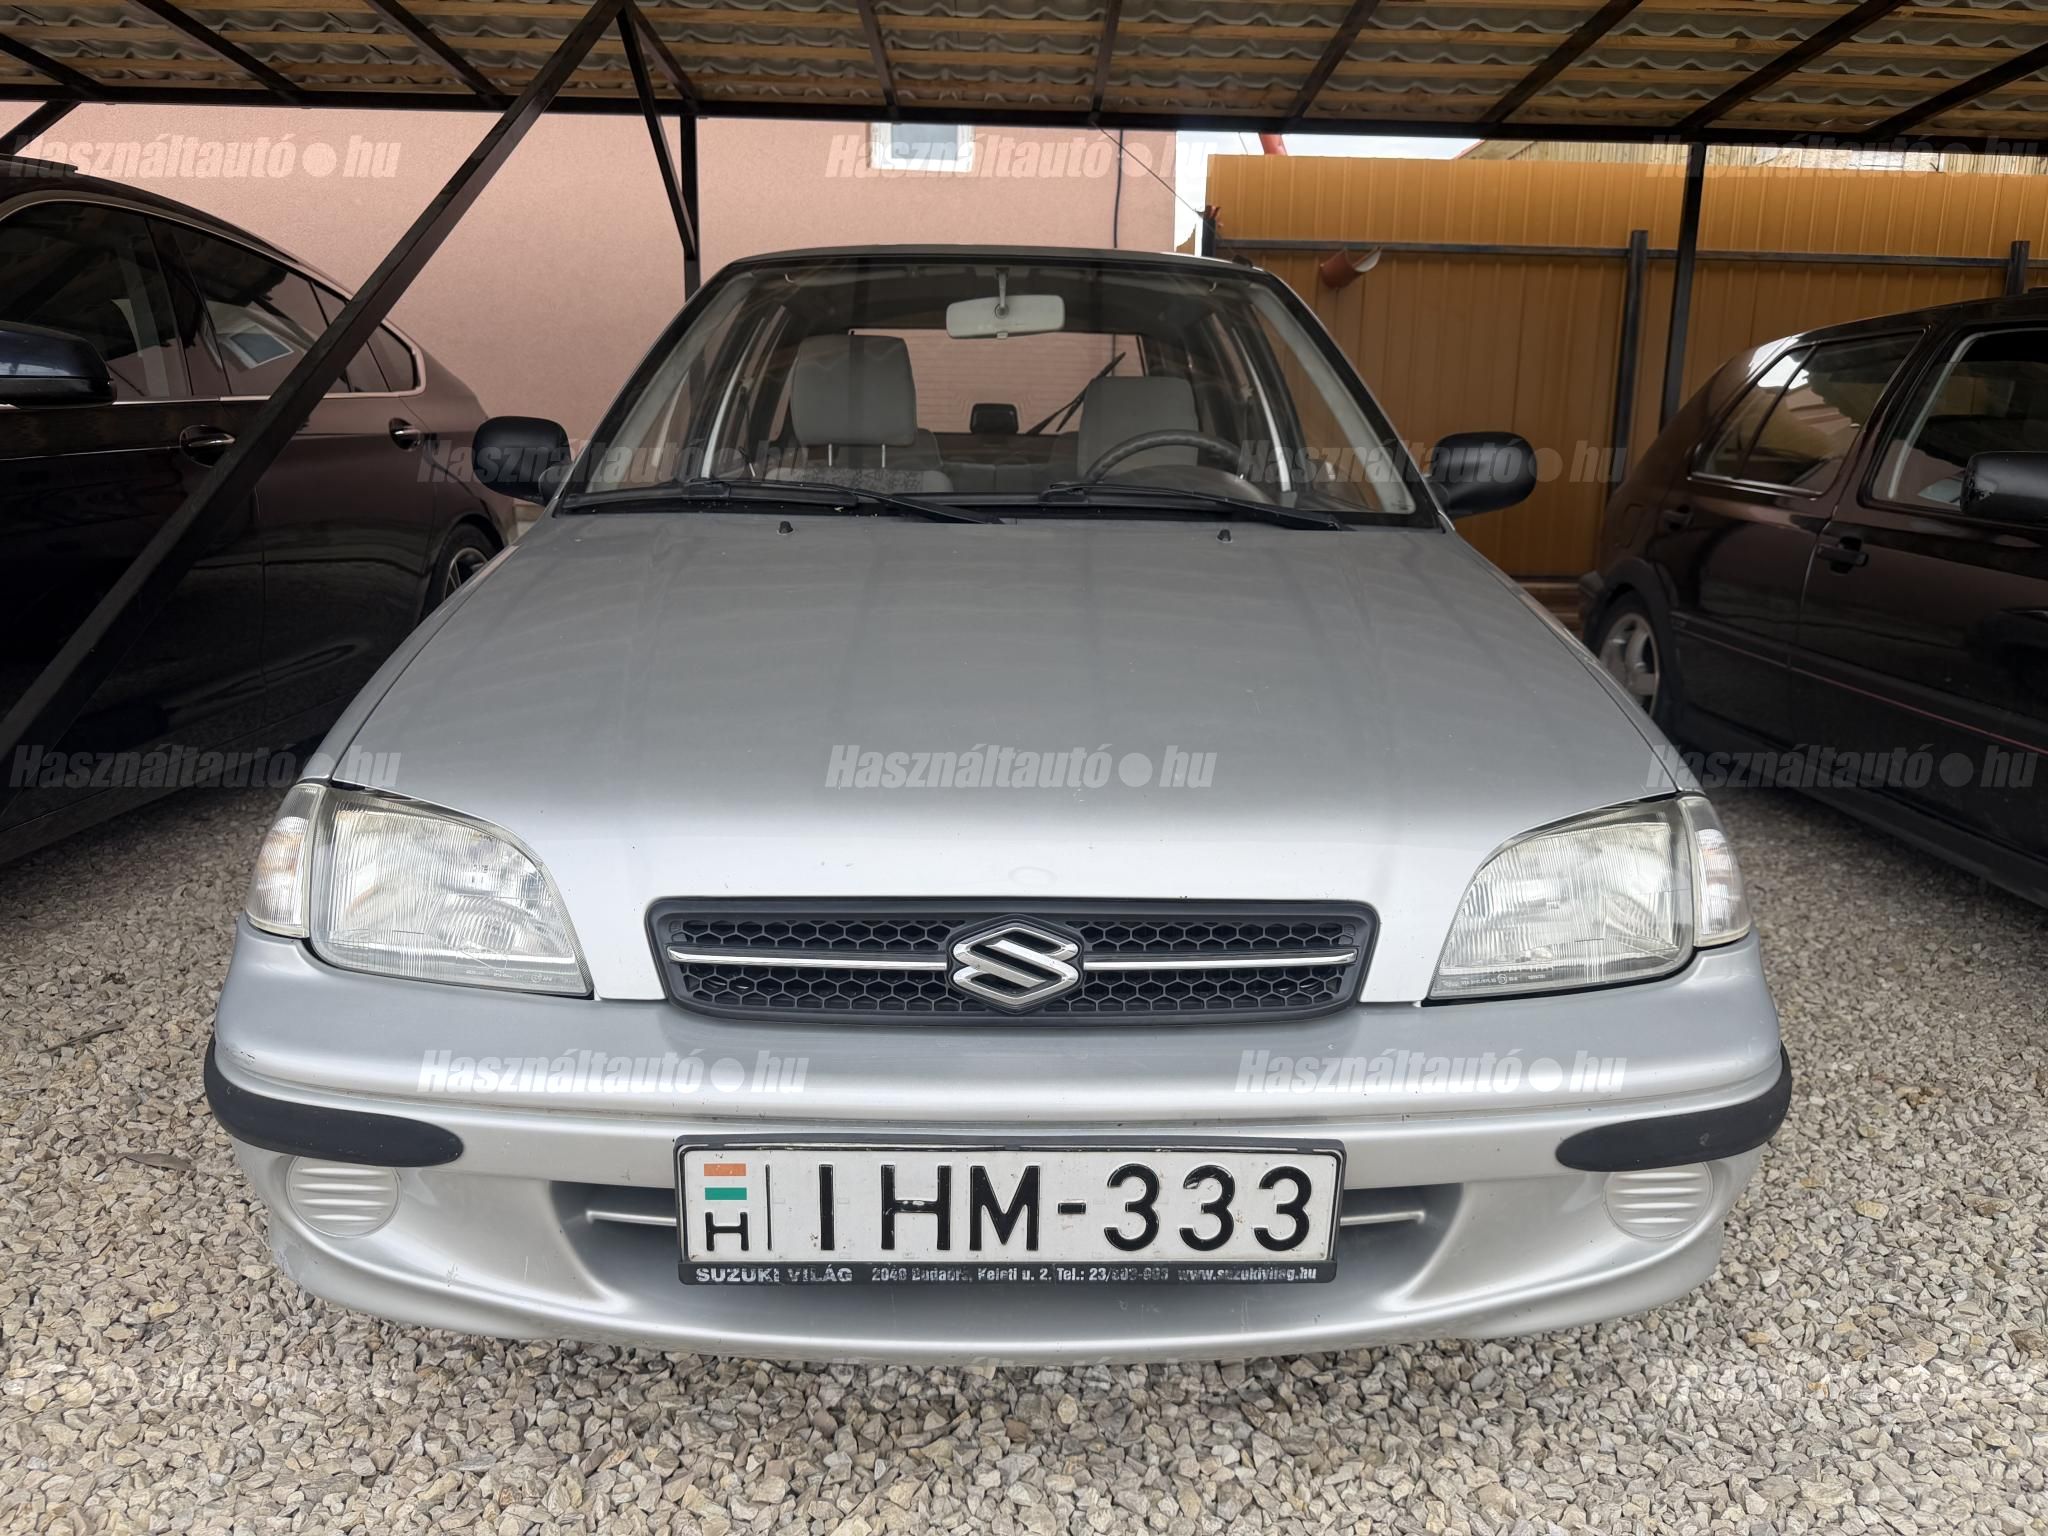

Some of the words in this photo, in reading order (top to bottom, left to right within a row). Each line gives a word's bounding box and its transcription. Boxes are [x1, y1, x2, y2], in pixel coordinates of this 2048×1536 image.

[819, 1163, 1312, 1251] IHM-333
[705, 1211, 750, 1252] H
[696, 1268, 781, 1283] SUZUKI
[788, 1264, 853, 1283] VILÁG
[1021, 1269, 1035, 1281] u.
[1039, 1267, 1052, 1281] 2.
[1056, 1267, 1085, 1281] Tel.:
